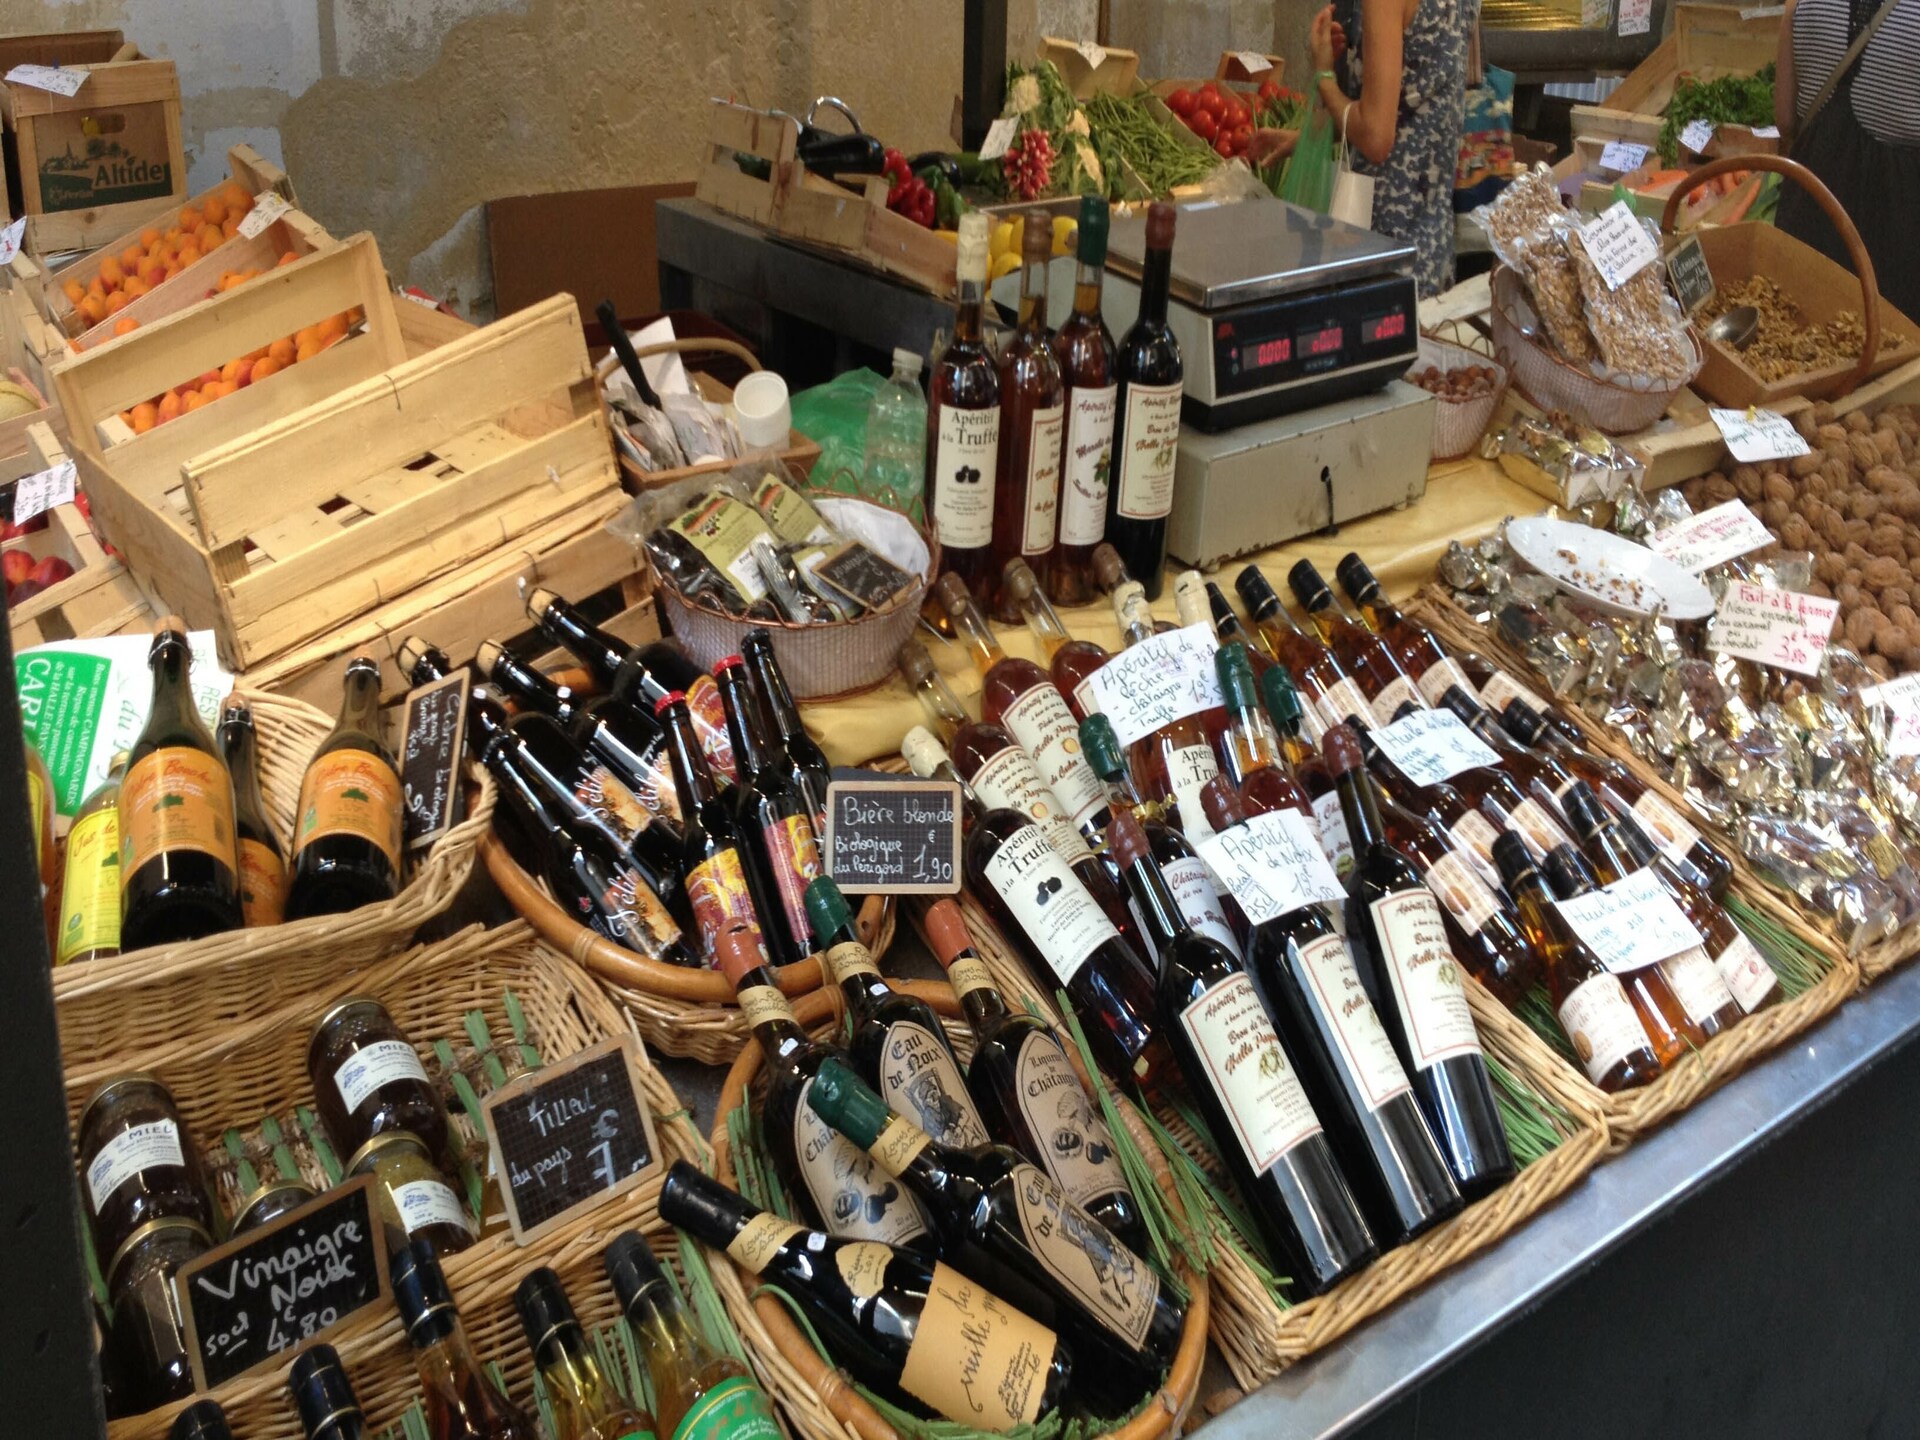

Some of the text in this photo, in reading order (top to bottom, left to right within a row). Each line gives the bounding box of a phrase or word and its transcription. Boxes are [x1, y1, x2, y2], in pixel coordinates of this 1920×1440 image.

[1726, 601, 1755, 615] Noix
[1740, 585, 1768, 605] Fait
[843, 796, 954, 826] Bière blonde
[835, 831, 902, 863] Biologique
[996, 825, 1039, 867] Apéritif
[834, 844, 952, 884] du Périgord 1,90
[892, 1034, 923, 1061] Eau
[906, 1047, 942, 1078] Noix
[527, 1088, 598, 1137] Tilleul
[129, 1125, 172, 1141] MIEL
[512, 1161, 532, 1188] du
[533, 1147, 573, 1188] pays
[197, 1220, 364, 1300] Vinaigre
[269, 1253, 357, 1312] Noix
